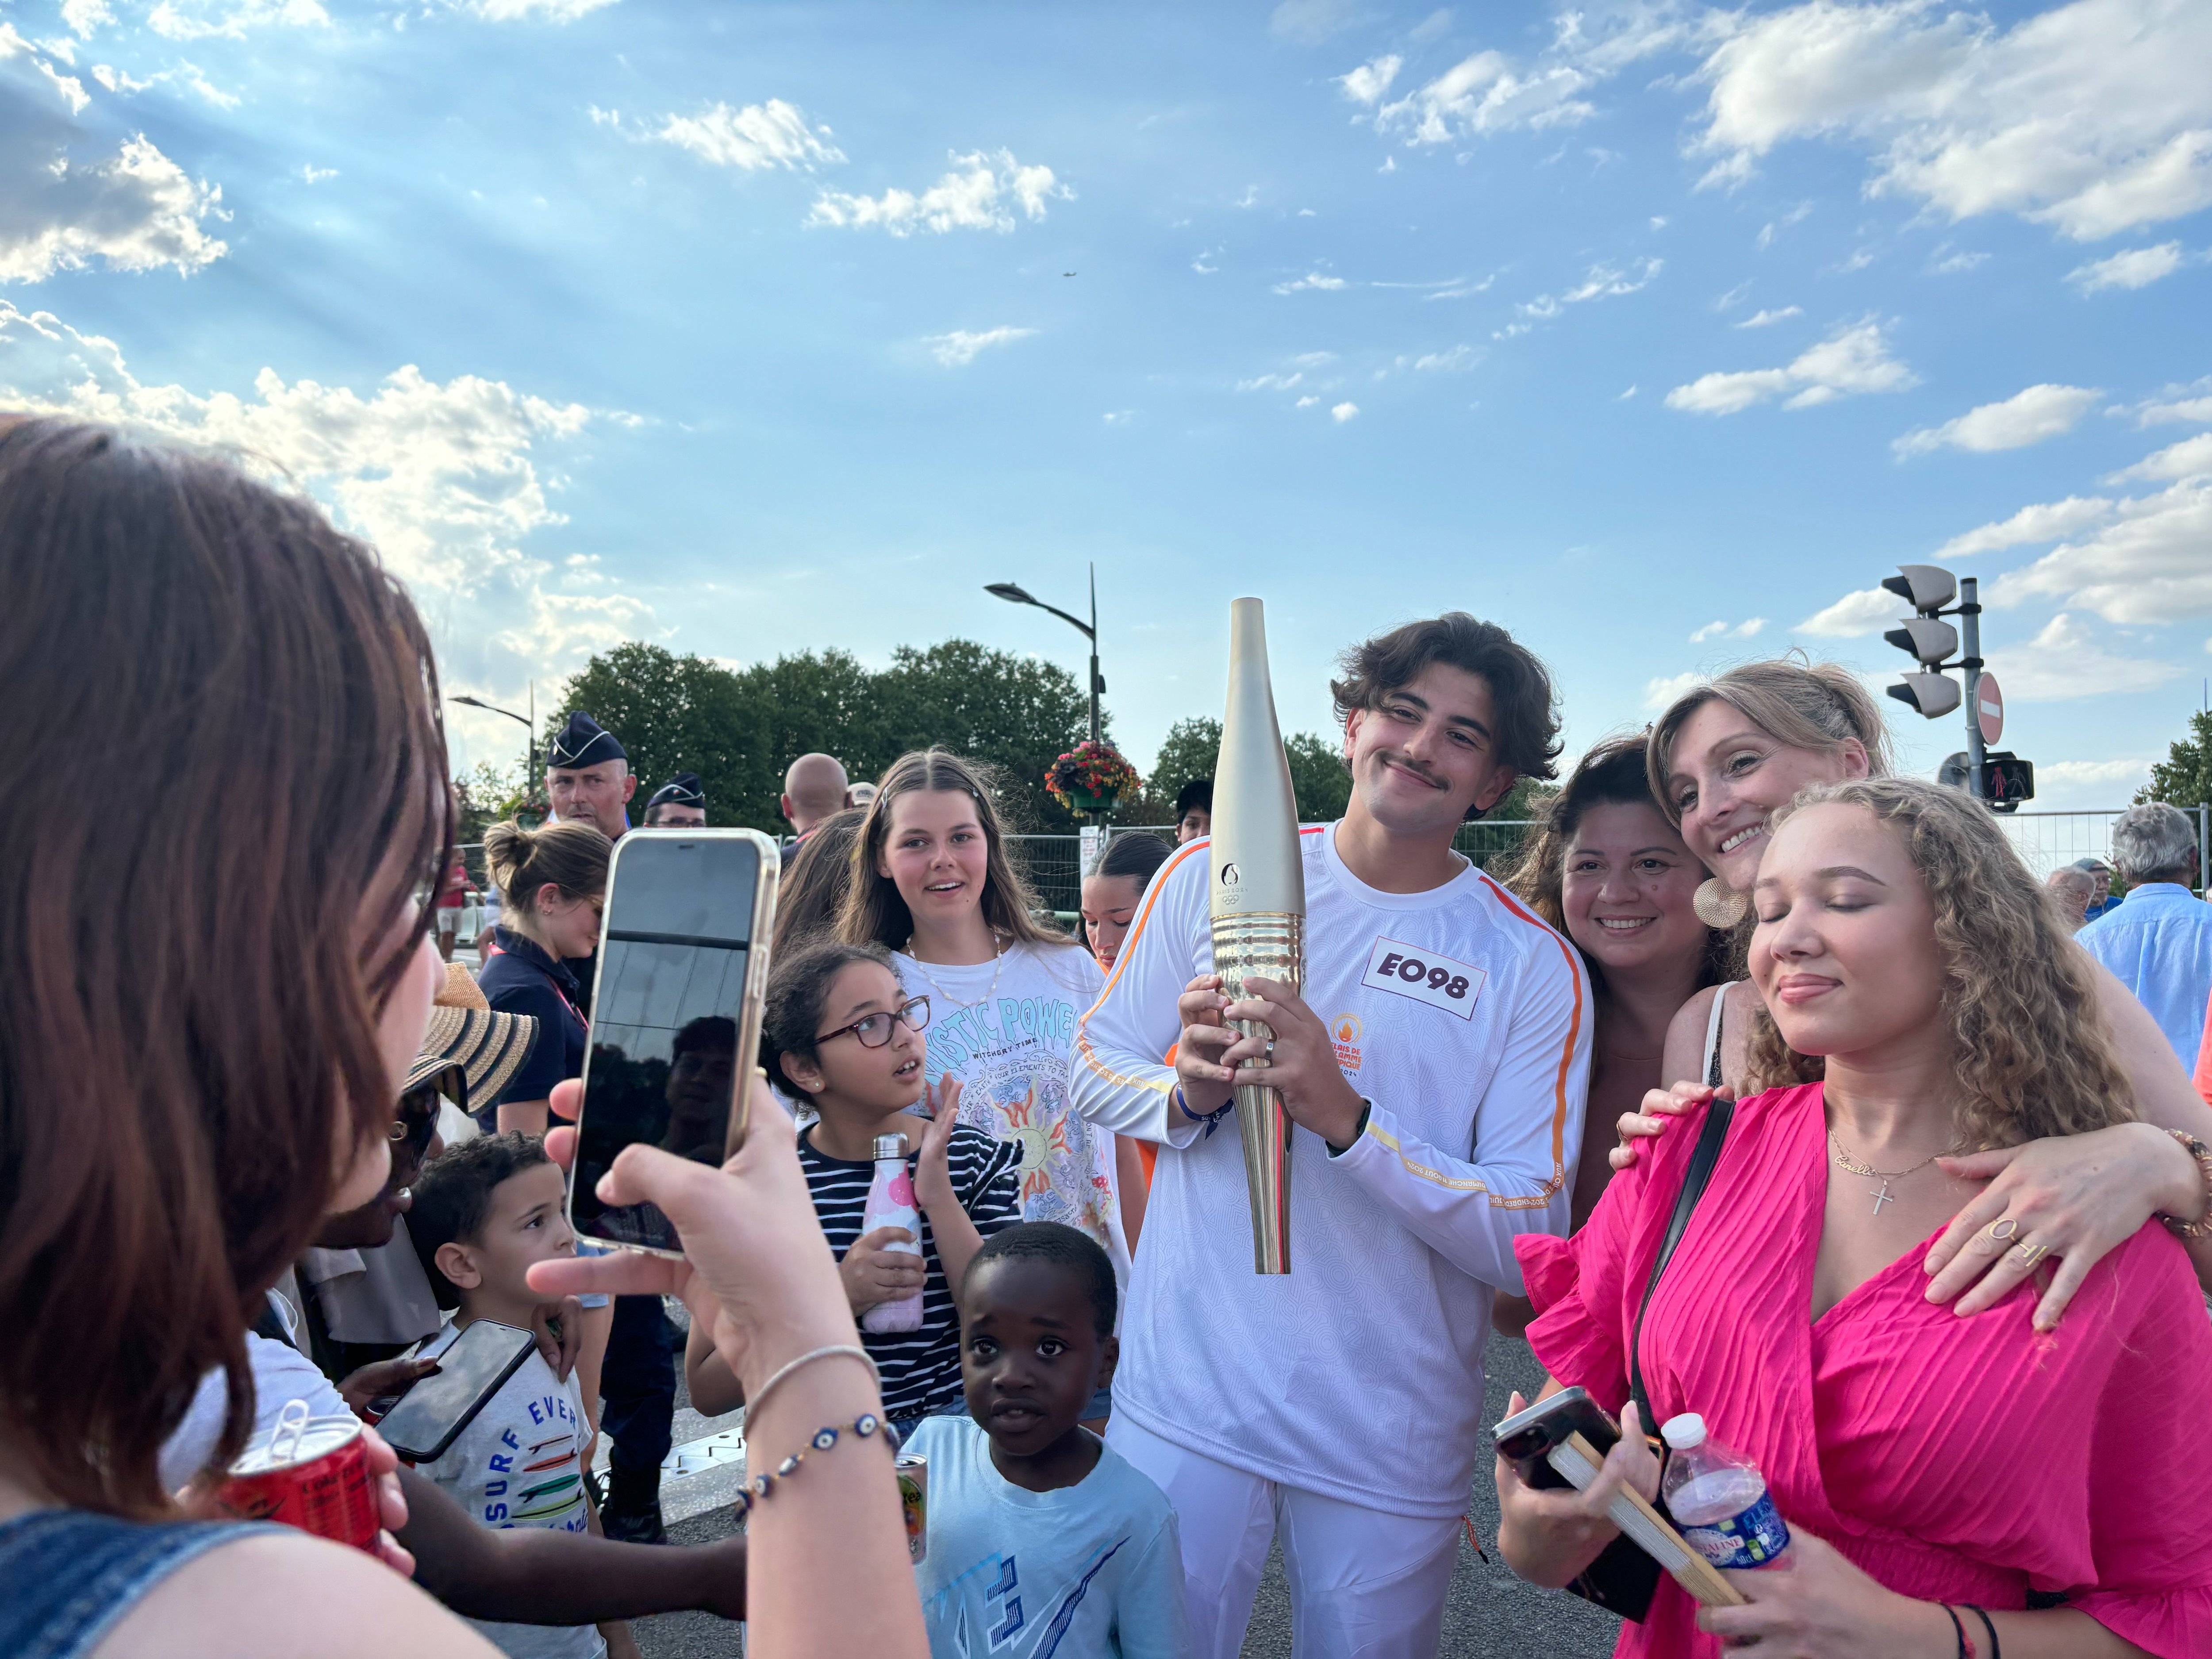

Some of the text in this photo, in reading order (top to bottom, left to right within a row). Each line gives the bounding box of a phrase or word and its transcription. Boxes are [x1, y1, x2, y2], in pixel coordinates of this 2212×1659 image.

[998, 997, 1077, 1049] POWE
[1016, 1037, 1037, 1048] TIME
[1332, 1043, 1350, 1052] LAIS
[1338, 1059, 1361, 1071] PIQUE
[1407, 1161, 1423, 1174] 2024
[1835, 1155, 1875, 1176] Canelle
[1448, 1179, 1486, 1189] DIMANCHE
[485, 1428, 520, 1521] SURF
